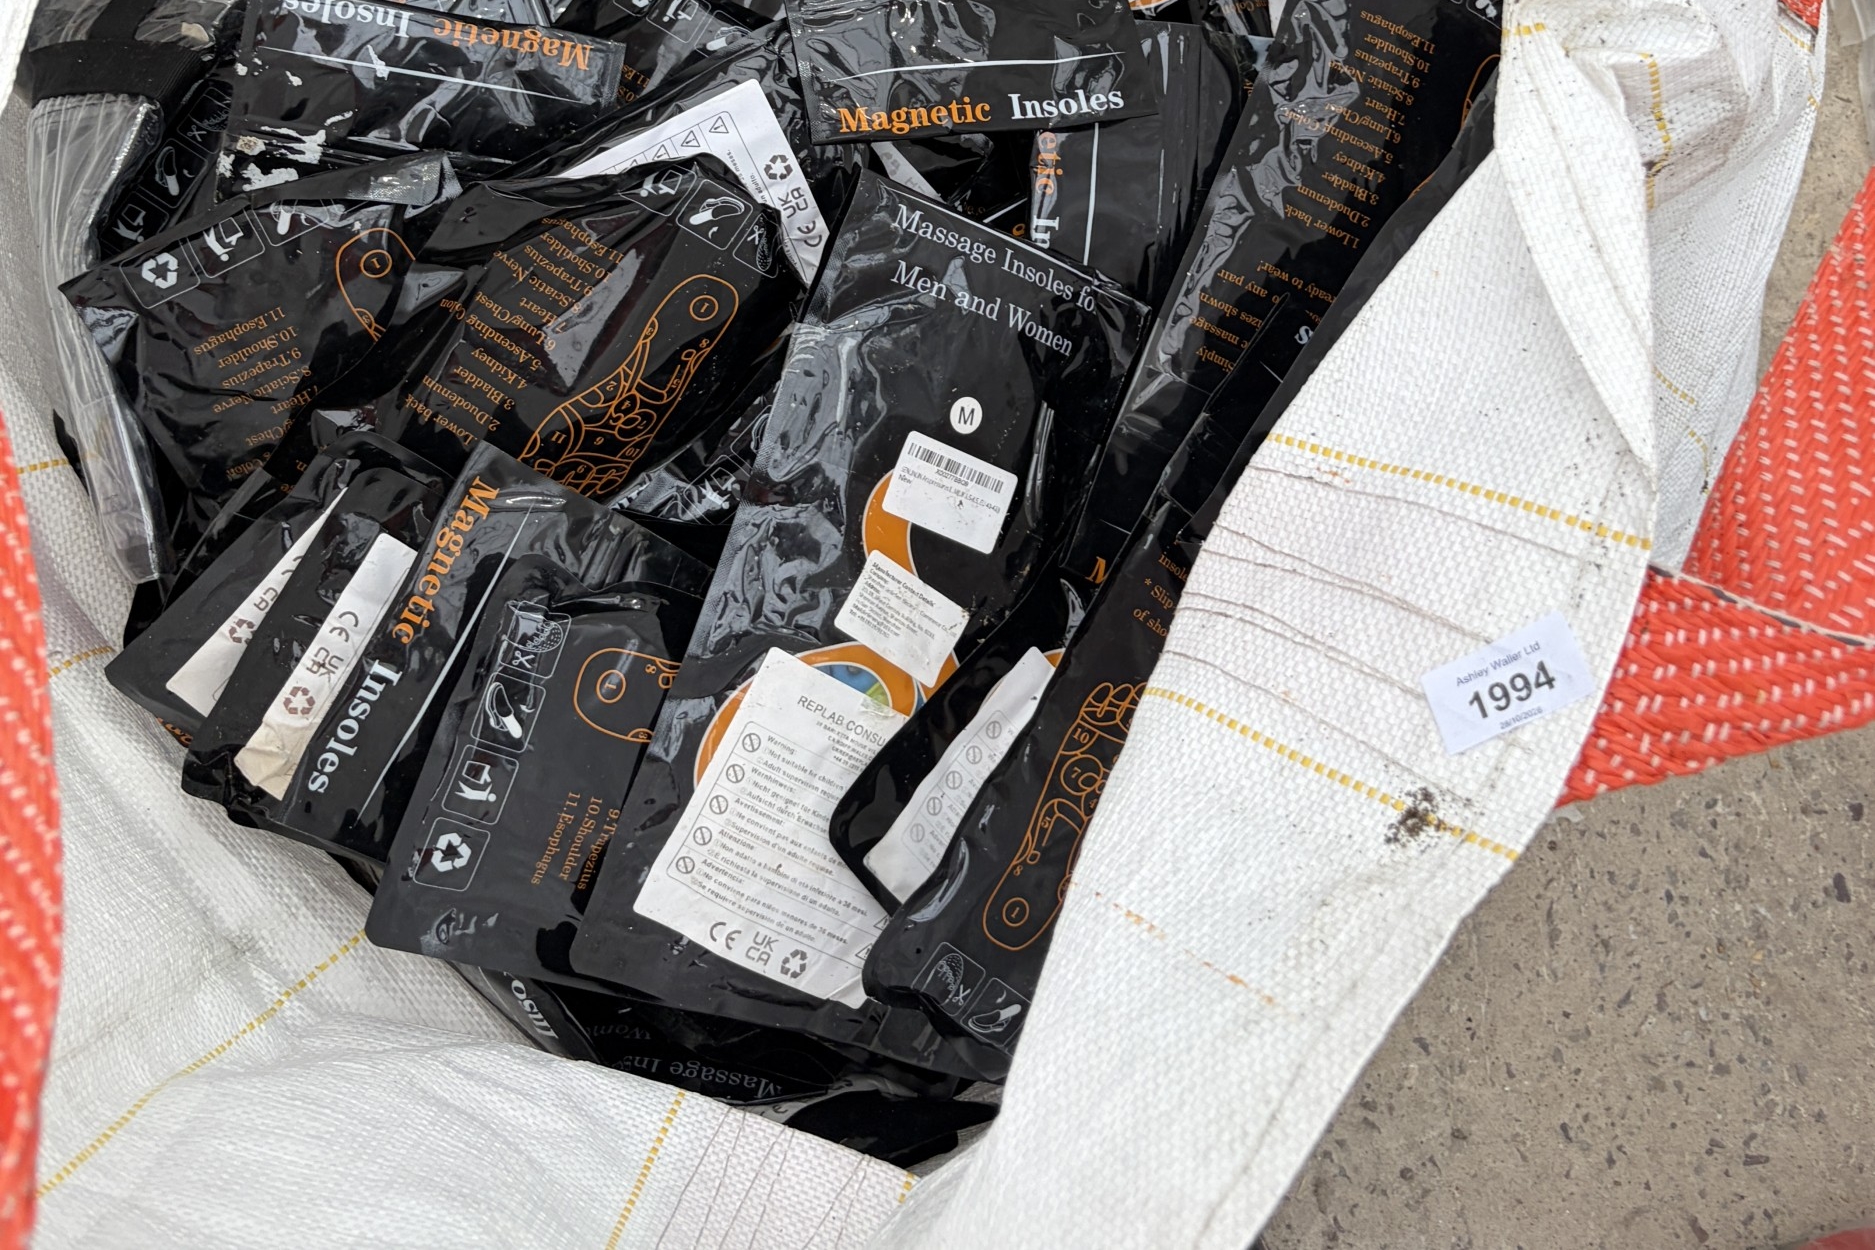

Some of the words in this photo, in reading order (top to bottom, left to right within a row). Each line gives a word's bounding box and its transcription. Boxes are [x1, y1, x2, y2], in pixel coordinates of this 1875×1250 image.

[433, 18, 592, 71] Magnetic
[1360, 10, 1434, 55] 11.Esophagus
[1364, 34, 1429, 73] 10.Shoulder
[1354, 49, 1420, 89] 9.Trapezius
[838, 97, 991, 134] Magnetic
[1009, 86, 1124, 121] Insoles
[1364, 98, 1405, 126] 7.Heart
[1368, 76, 1414, 106] 8.Sciatic
[1324, 122, 1393, 164] 5.Ascending
[1325, 105, 1401, 143] 6.Lung/Chest
[1321, 172, 1377, 205] 3.Bladder
[1333, 151, 1384, 184] 4.Kidney
[1285, 204, 1312, 228] back
[1296, 185, 1369, 228] 2.Duodenum
[1313, 219, 1359, 248] 1.Lower
[523, 245, 593, 297] 9.Trapezius
[540, 232, 612, 282] 10.Shoulder
[889, 203, 1002, 267] Massage
[996, 248, 1079, 301] Insoles
[1074, 284, 1103, 313] fo
[1214, 265, 1245, 289] pair
[1256, 262, 1289, 282] wear!
[528, 277, 580, 313] 8.Sciatic
[1244, 281, 1267, 297] any
[1291, 277, 1303, 290] to
[439, 298, 466, 321] Colon
[474, 291, 562, 350] 6.Lung/Chest
[889, 259, 952, 300] Men
[952, 286, 1003, 321] and
[1000, 303, 1079, 356] Women
[193, 306, 285, 355] 11.Esophagus
[217, 326, 297, 369] 10.Shoulder
[464, 314, 542, 371] 5.Ascending
[1190, 317, 1238, 345] massage
[221, 346, 302, 389] 9.Trapezius
[254, 367, 312, 397] 8.Sciatic
[452, 366, 514, 410] 3.Bladder
[471, 347, 527, 390] 4.Kidney
[213, 394, 253, 414] Nerve
[404, 394, 433, 422] back
[421, 375, 500, 431] 2.Duodenum
[958, 407, 976, 425] M
[391, 476, 500, 645] Magnetic
[1132, 609, 1151, 622] of
[1151, 585, 1174, 610] Slip
[1454, 666, 1490, 687] Ashley
[1523, 640, 1541, 655] Ltd
[796, 694, 845, 726] REPLAB
[1463, 658, 1560, 721] 1994
[309, 660, 402, 792] Insoles
[531, 792, 581, 886] 11.Esophagus
[560, 798, 602, 881] 10.Shoulder
[577, 809, 621, 890] 9.Trapezius
